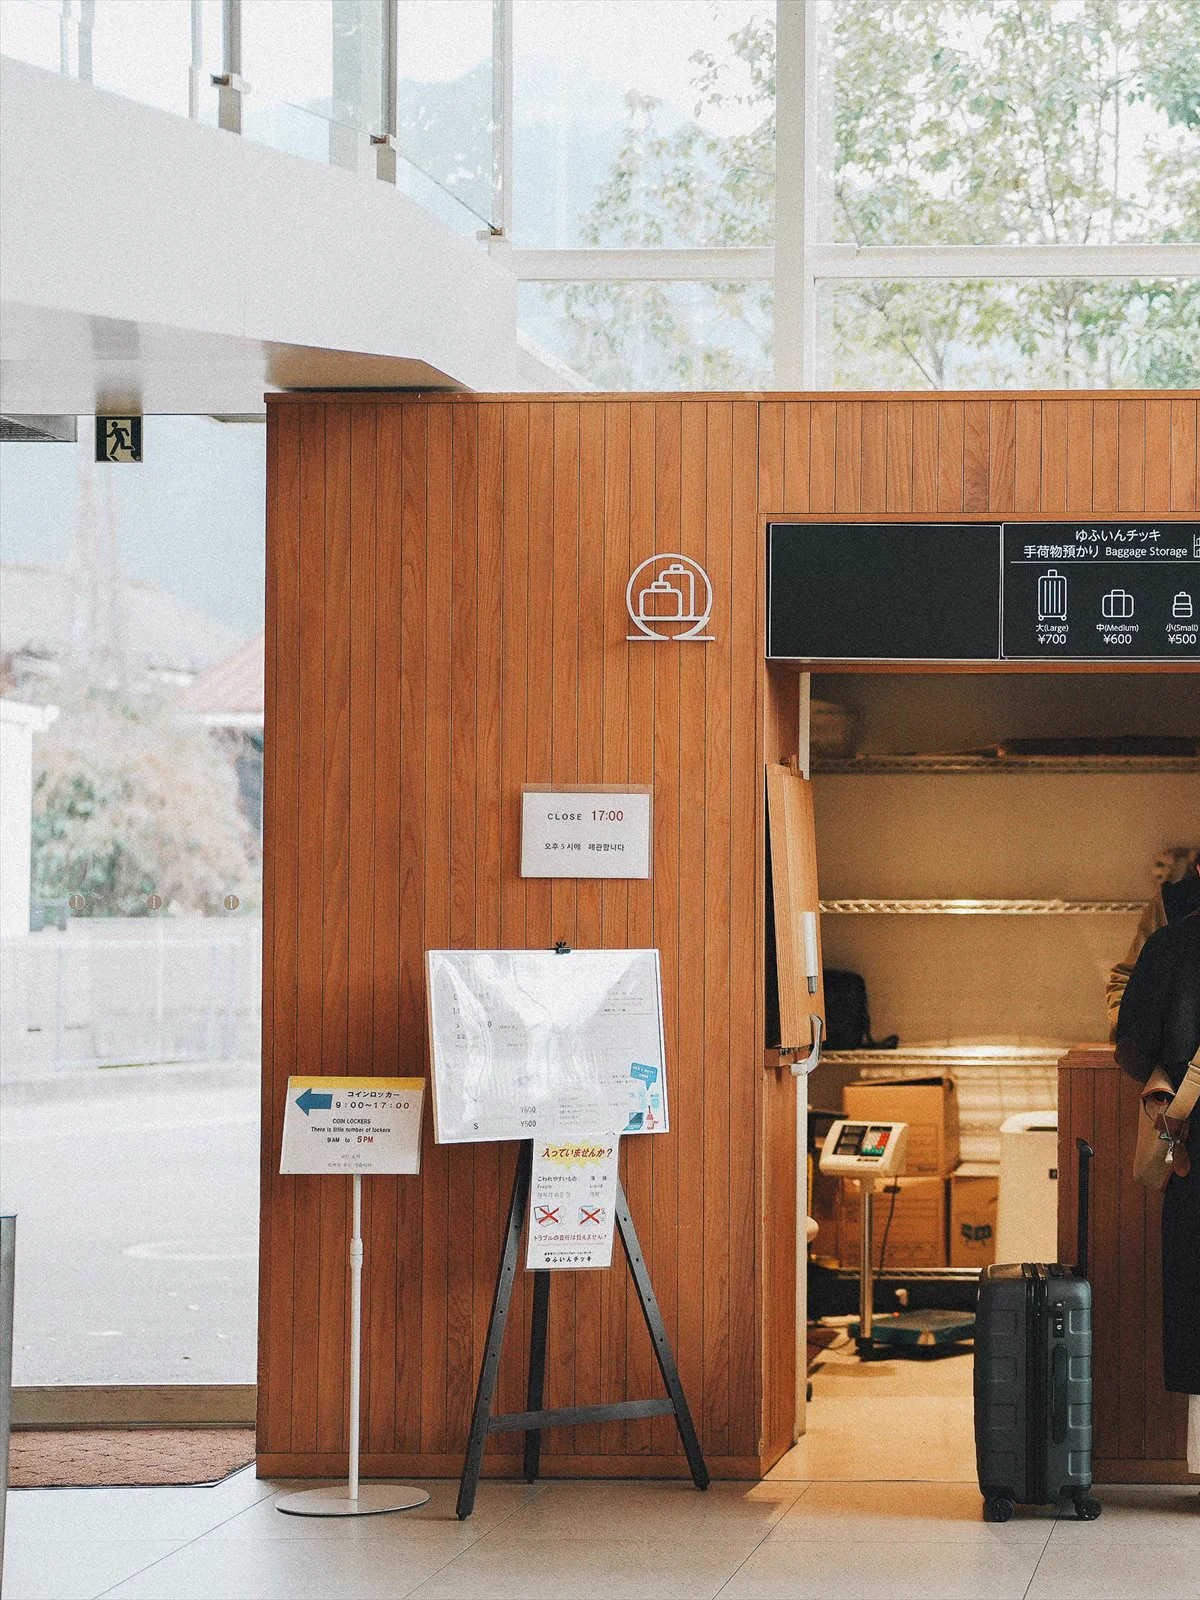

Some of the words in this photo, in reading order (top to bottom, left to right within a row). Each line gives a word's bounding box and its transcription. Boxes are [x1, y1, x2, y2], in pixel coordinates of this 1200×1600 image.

[1075, 529, 1161, 542] ゆふいんチッキ
[1024, 544, 1098, 558] 手荷物預かり
[1105, 546, 1146, 559] Baggage
[1150, 546, 1188, 558] Storage
[1035, 624, 1069, 632] 大(Large)
[1096, 623, 1139, 632] 中(Medium)
[1166, 623, 1199, 632] 小(Small)
[1038, 634, 1067, 644] ¥700
[1103, 634, 1132, 644] ¥600
[1168, 634, 1196, 644] ¥500
[592, 810, 624, 822] 17:00
